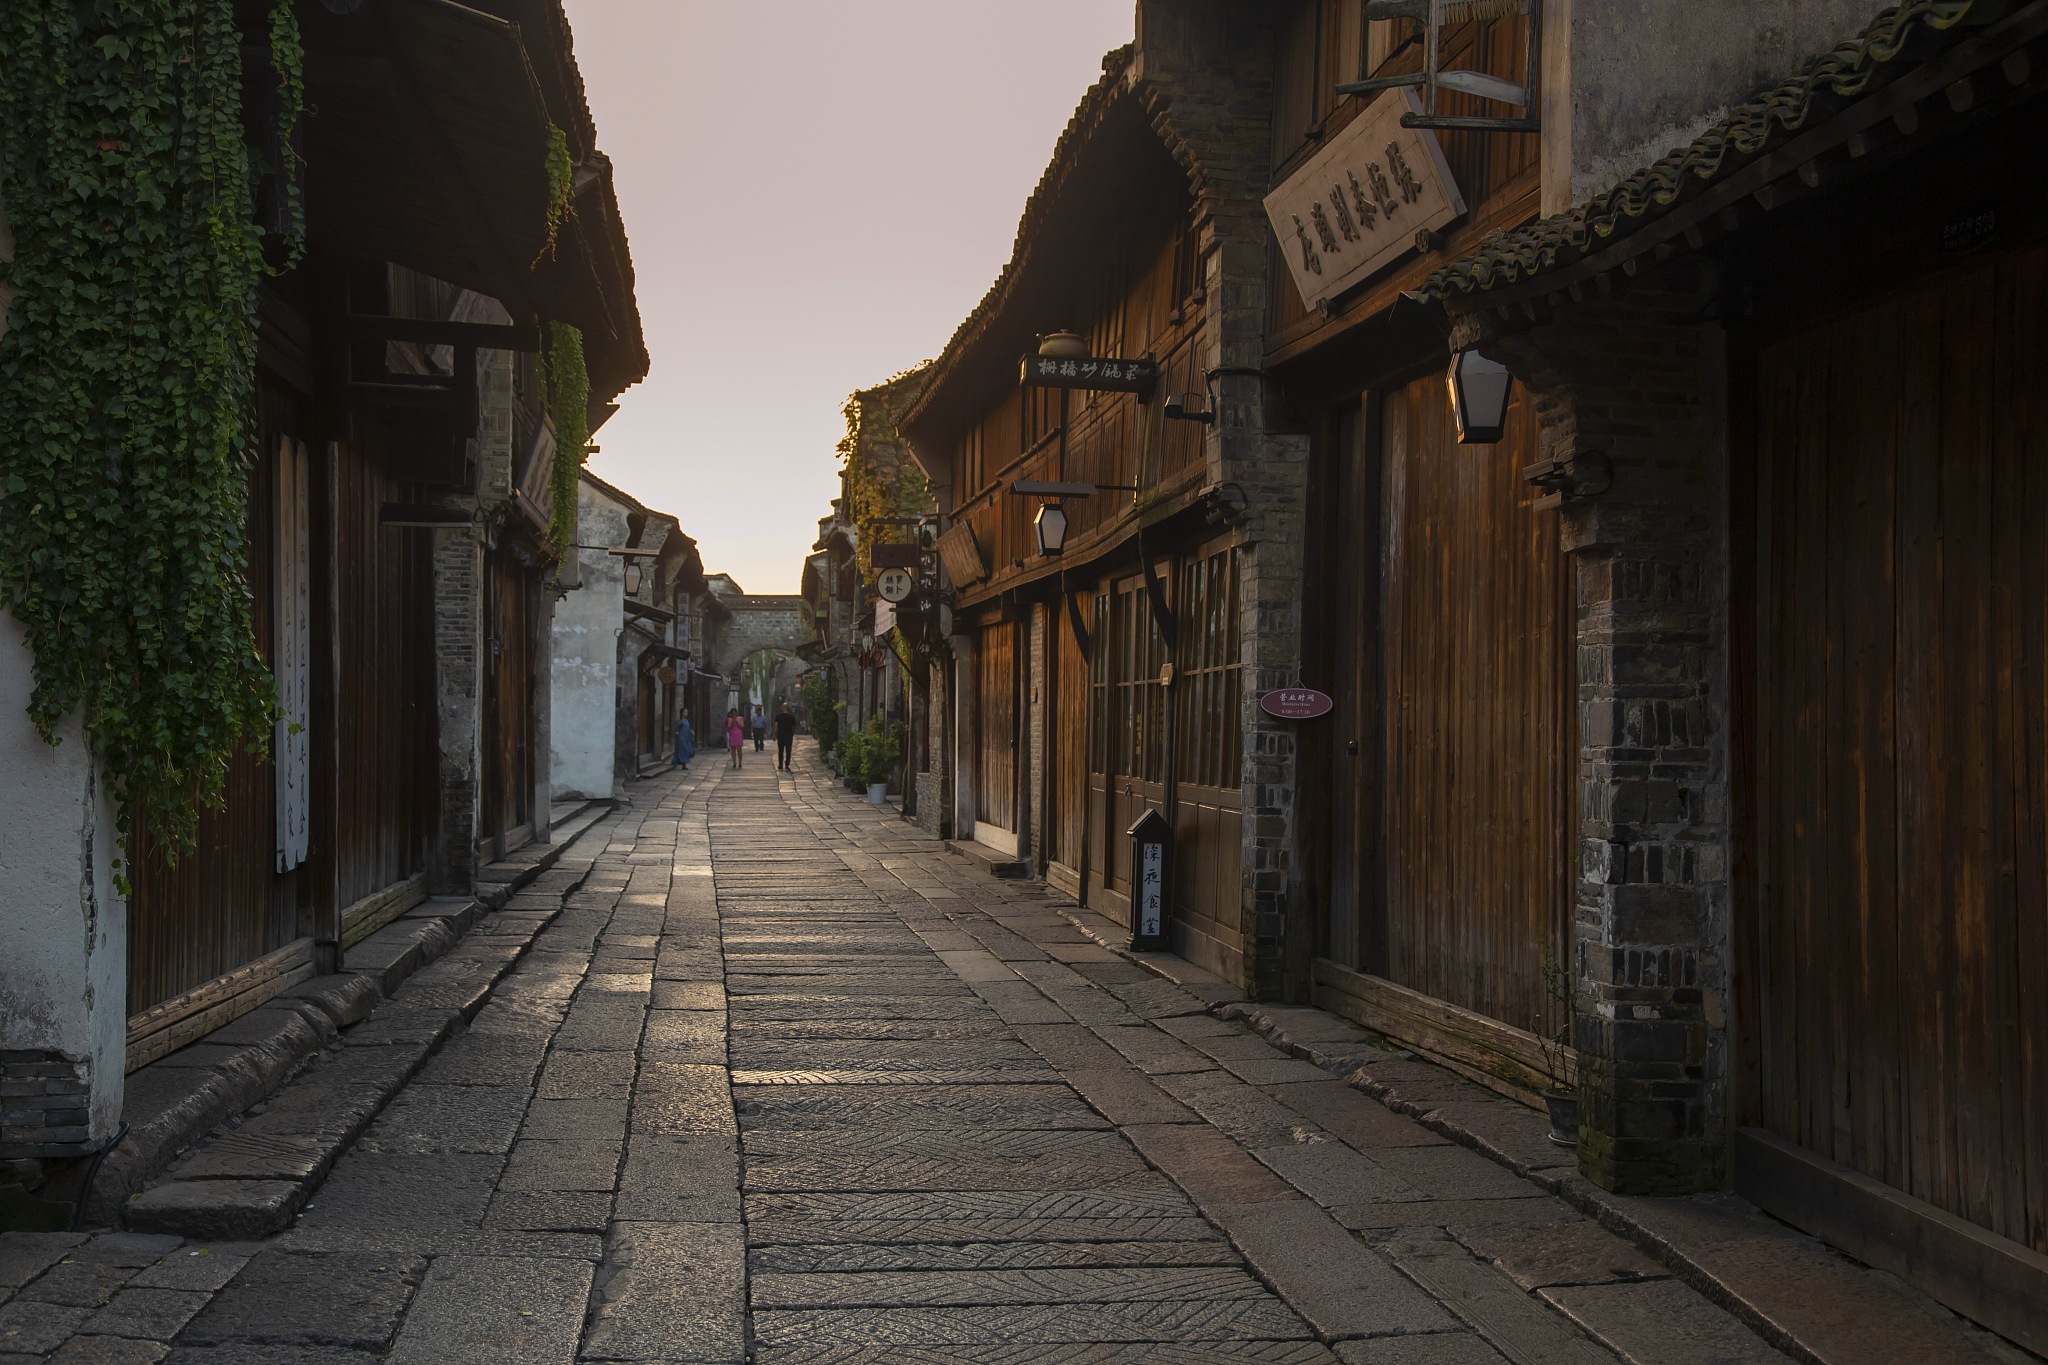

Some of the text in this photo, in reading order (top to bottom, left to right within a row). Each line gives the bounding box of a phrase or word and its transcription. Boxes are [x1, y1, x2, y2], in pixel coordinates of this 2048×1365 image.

[1280, 693, 1315, 702] 营业时间
[1143, 844, 1161, 934] 深夜食堂
